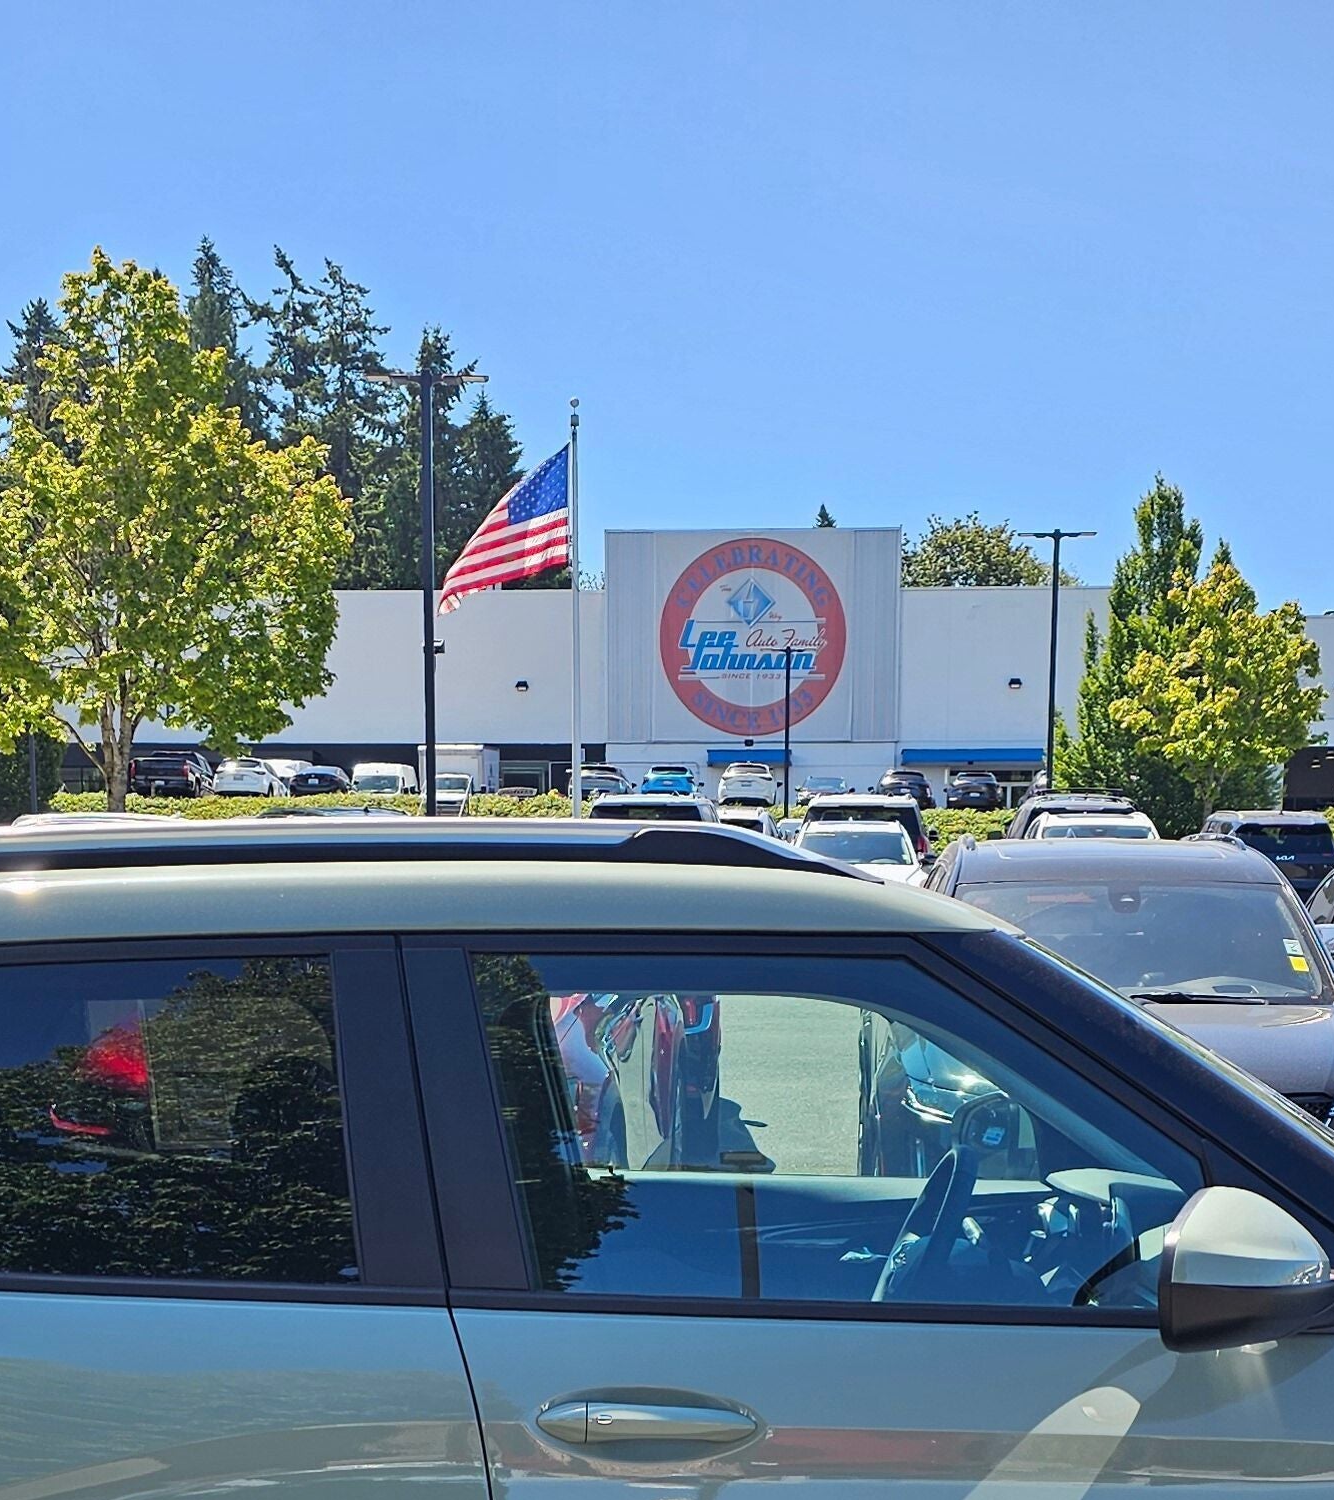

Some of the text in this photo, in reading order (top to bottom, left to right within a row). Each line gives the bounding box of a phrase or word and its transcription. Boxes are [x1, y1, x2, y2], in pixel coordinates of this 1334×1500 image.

[675, 545, 830, 608] CELEBRATING
[679, 619, 739, 648] Lee
[746, 628, 828, 651] Auto Family
[681, 645, 816, 671] Johnson
[693, 690, 761, 730] SINCE
